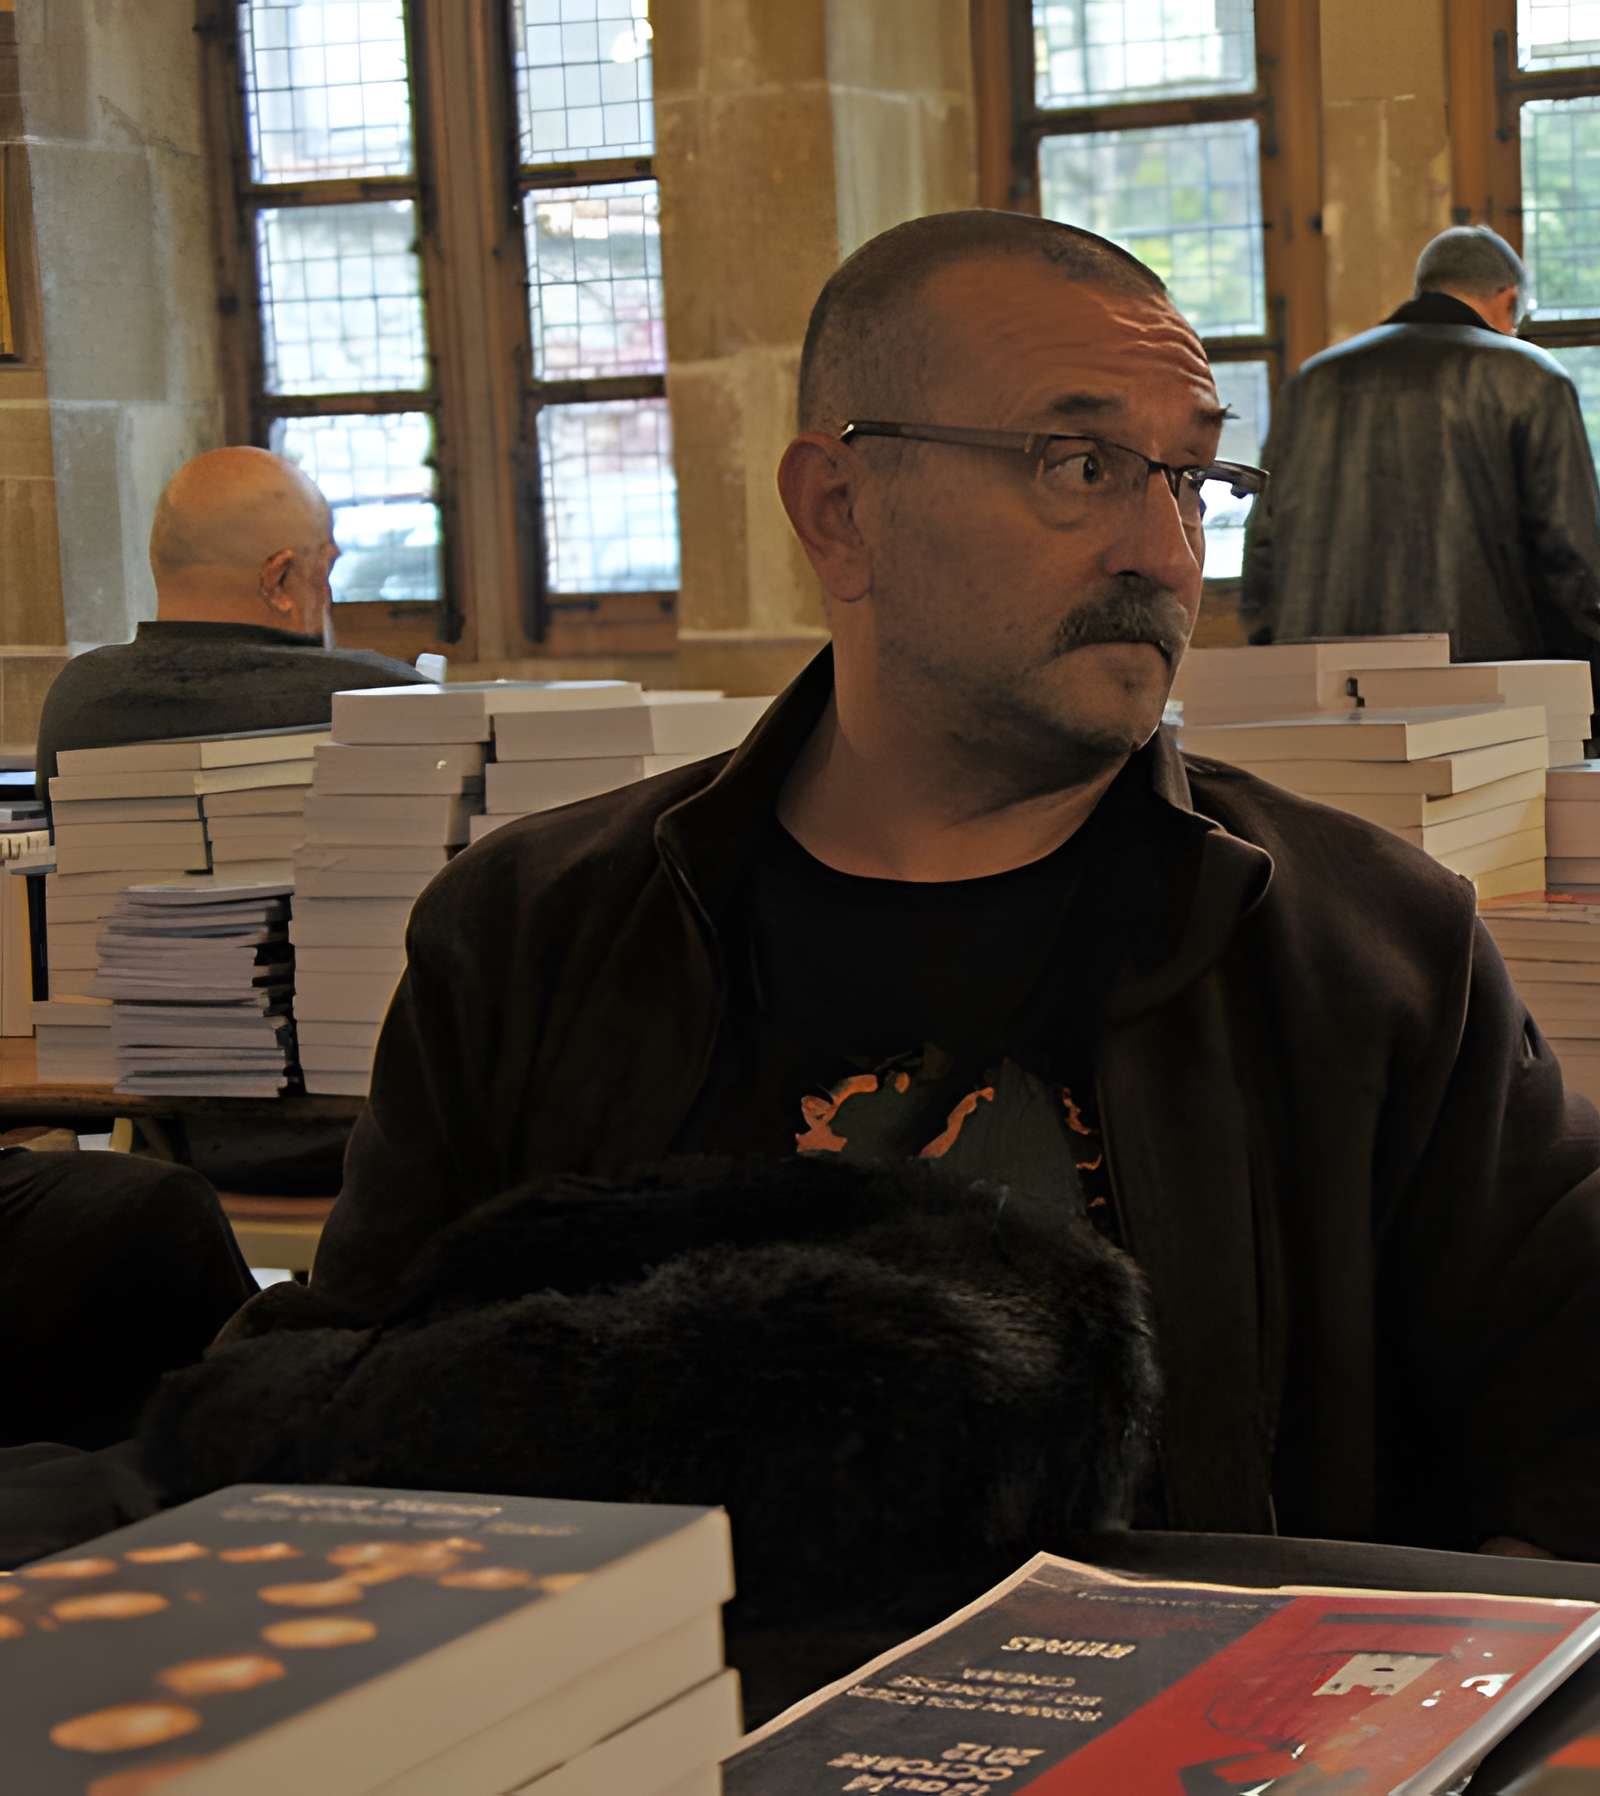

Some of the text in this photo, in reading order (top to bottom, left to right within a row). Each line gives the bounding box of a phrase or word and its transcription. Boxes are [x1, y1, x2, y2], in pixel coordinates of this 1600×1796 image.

[1001, 1637, 1135, 1659] REIMS
[943, 1743, 1044, 1765] 2012
[827, 1753, 1013, 1781] OCTOBRE
